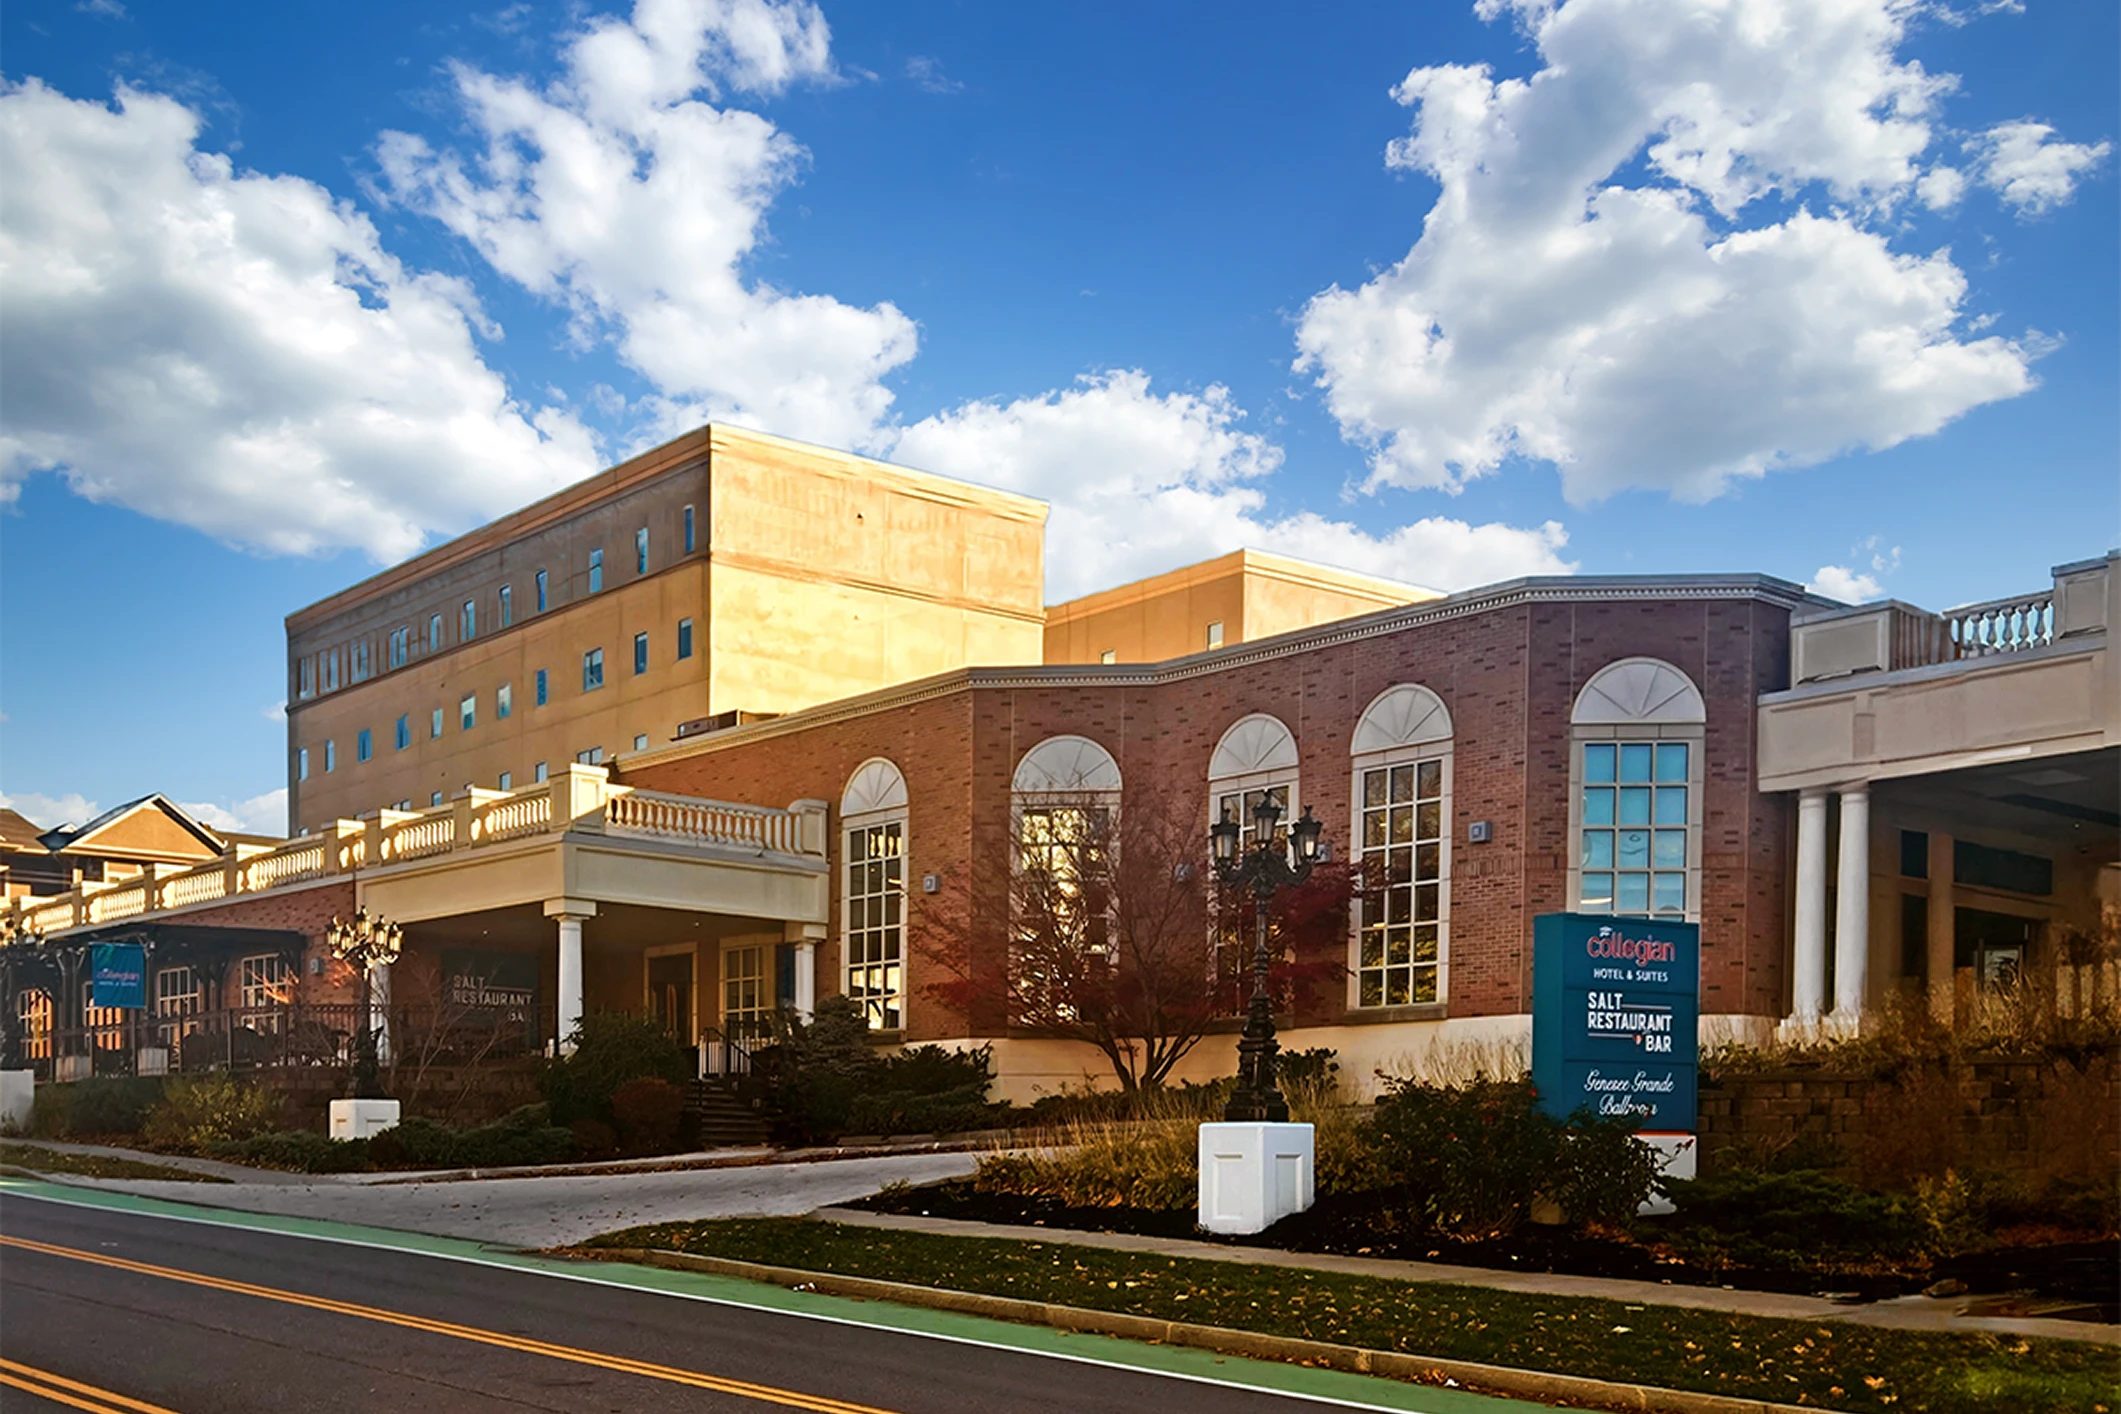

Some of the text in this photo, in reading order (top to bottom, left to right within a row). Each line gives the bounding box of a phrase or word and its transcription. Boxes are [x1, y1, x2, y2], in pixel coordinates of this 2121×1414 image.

[453, 975, 485, 989] SALT
[1593, 968, 1669, 983] HOTEL & SUITES
[453, 990, 533, 1006] RESTAURANT
[1587, 991, 1623, 1010] SALT
[1587, 1011, 1673, 1031] RESTAURANT
[1645, 1034, 1672, 1053] BAR
[1584, 1068, 1675, 1093] Genesee Grande
